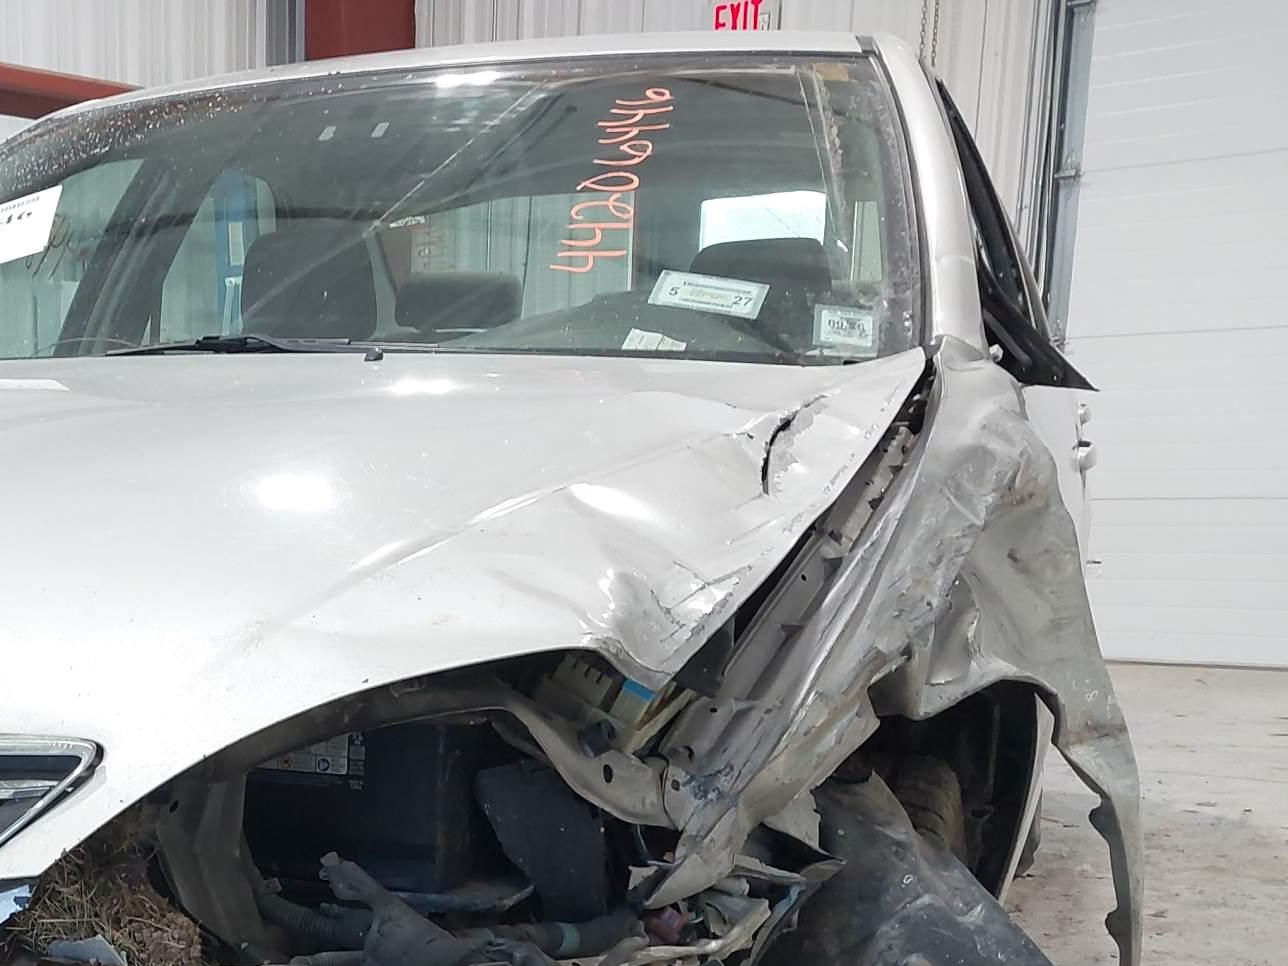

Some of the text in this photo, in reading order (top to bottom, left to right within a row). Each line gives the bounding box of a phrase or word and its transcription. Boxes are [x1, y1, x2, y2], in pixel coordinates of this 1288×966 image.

[550, 87, 675, 273] 44206446
[668, 286, 680, 297] 5
[731, 295, 753, 307] 27
